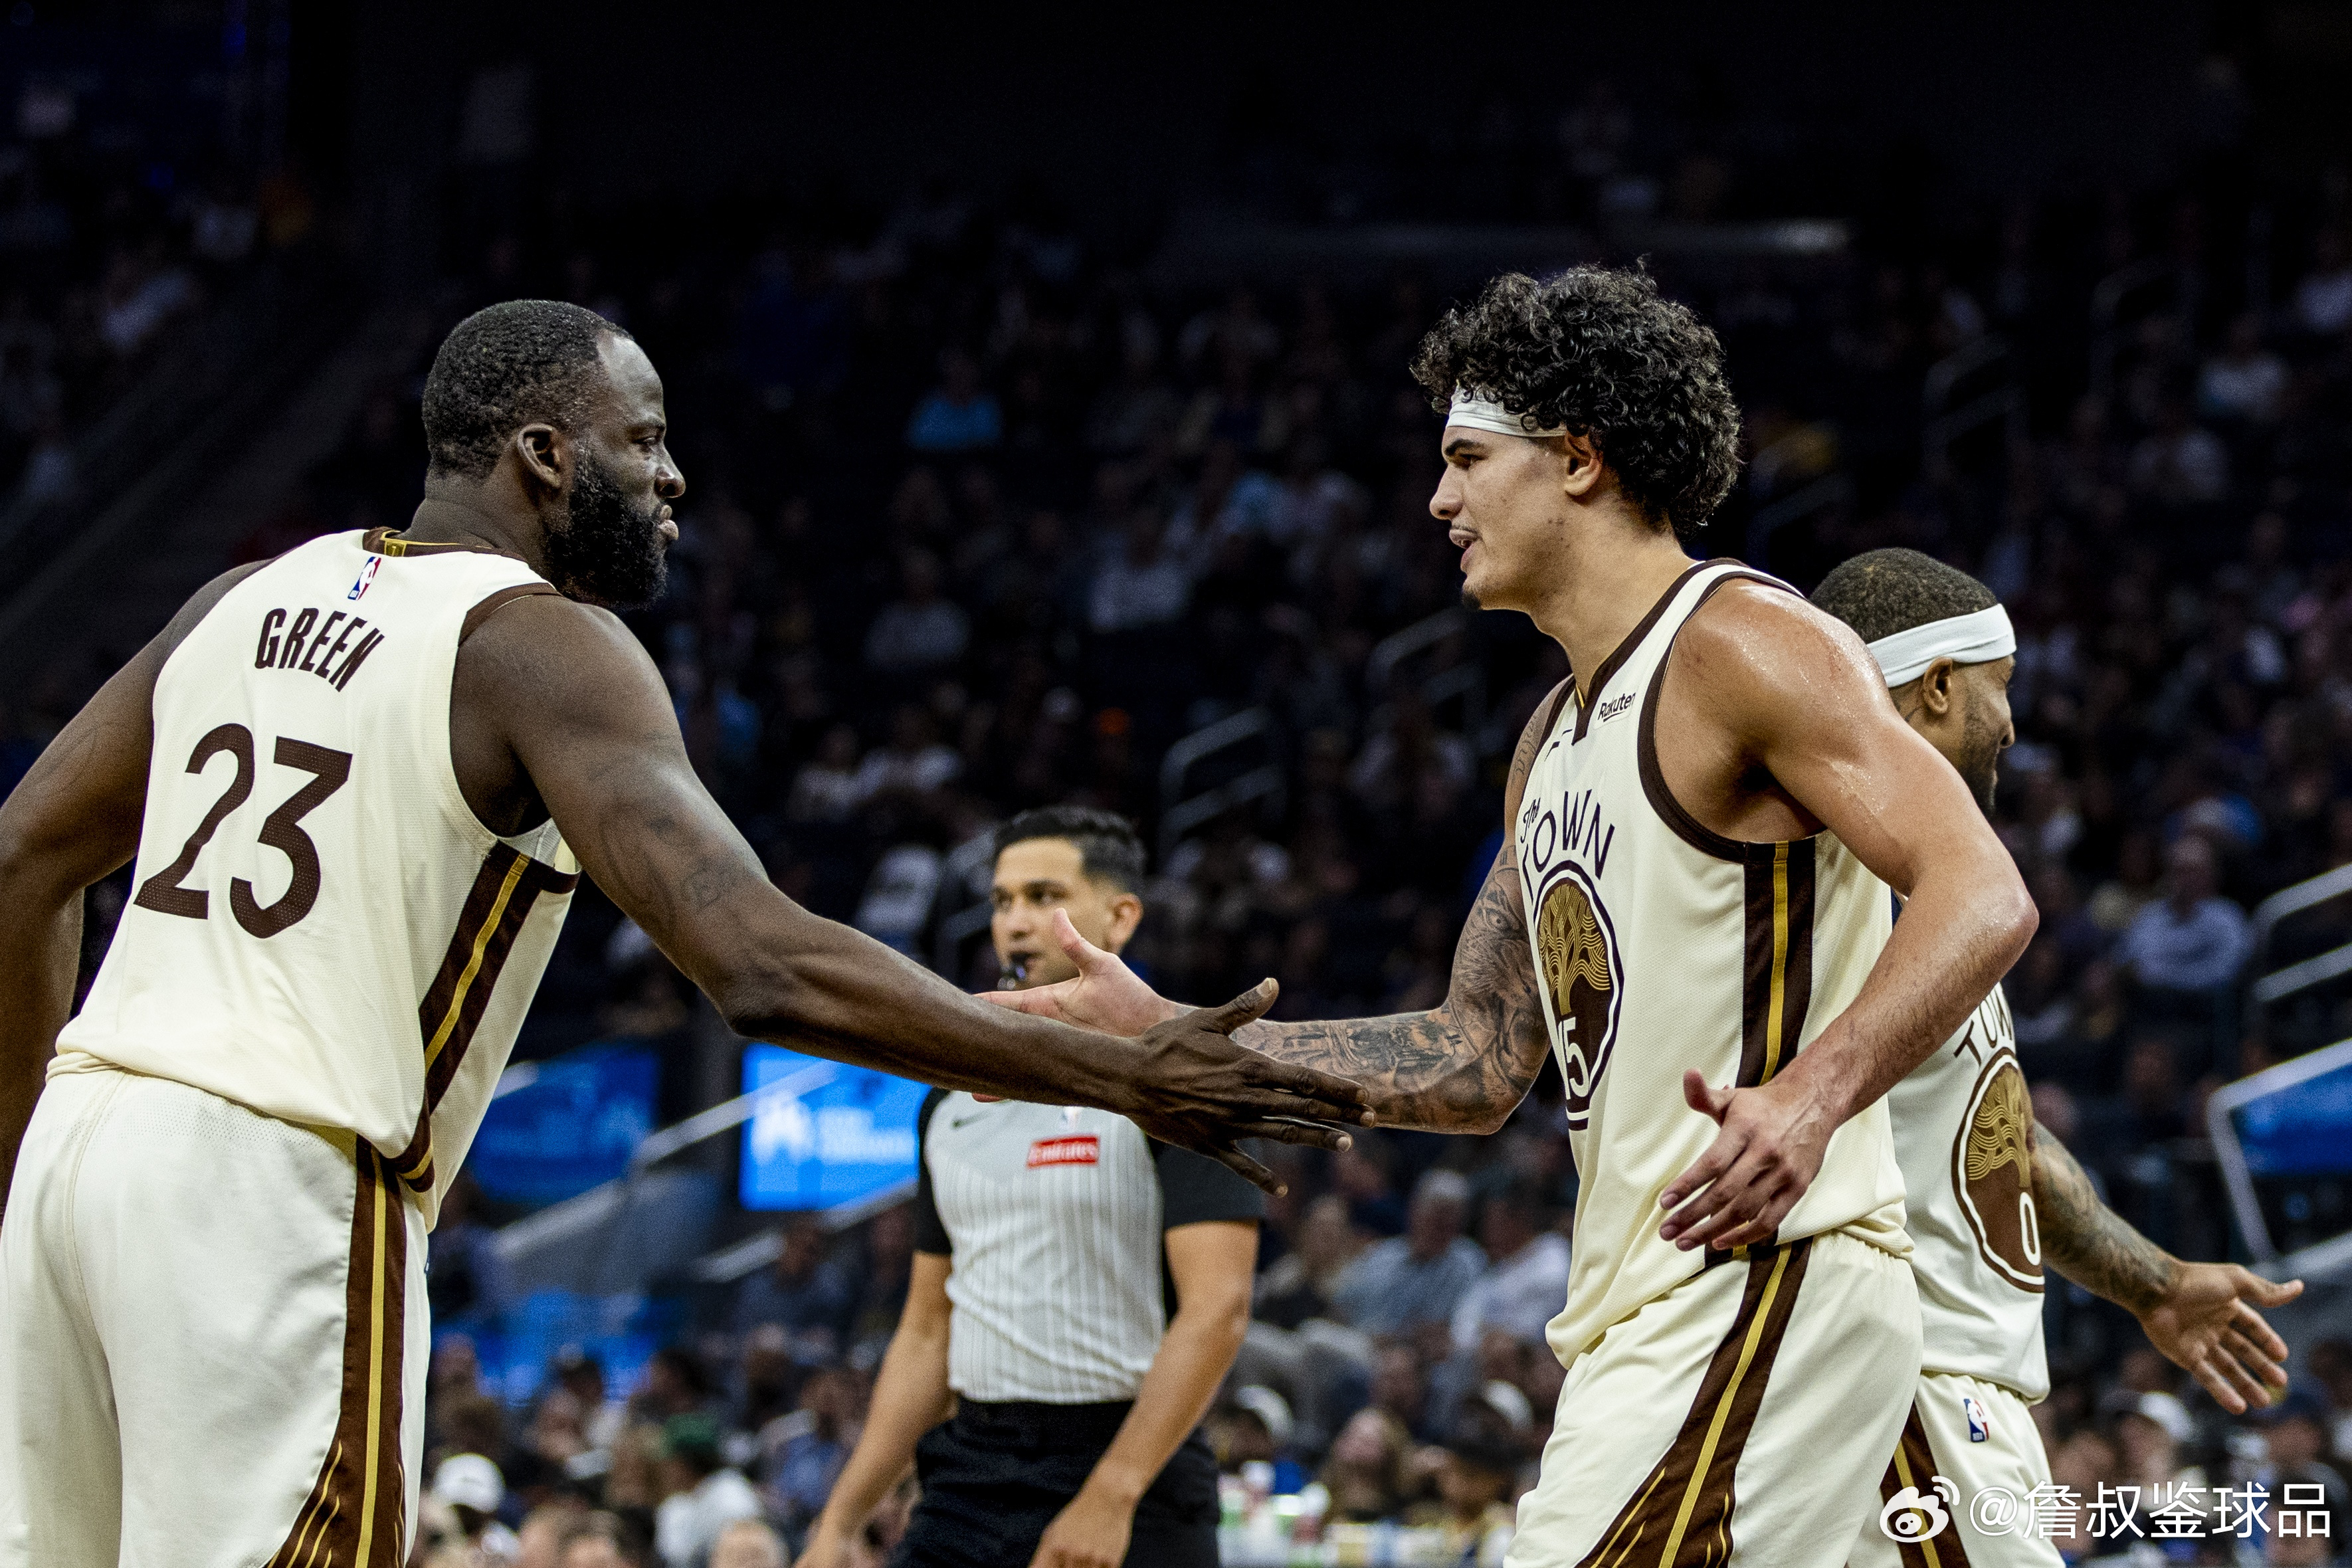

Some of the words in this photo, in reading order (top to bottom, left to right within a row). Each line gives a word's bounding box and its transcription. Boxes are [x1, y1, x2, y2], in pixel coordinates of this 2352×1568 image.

[254, 608, 385, 692] GREEN
[1597, 692, 1636, 720] Rakuten
[133, 723, 353, 939] 23
[1558, 1017, 1589, 1100] 15
[2020, 1191, 2041, 1266] 0
